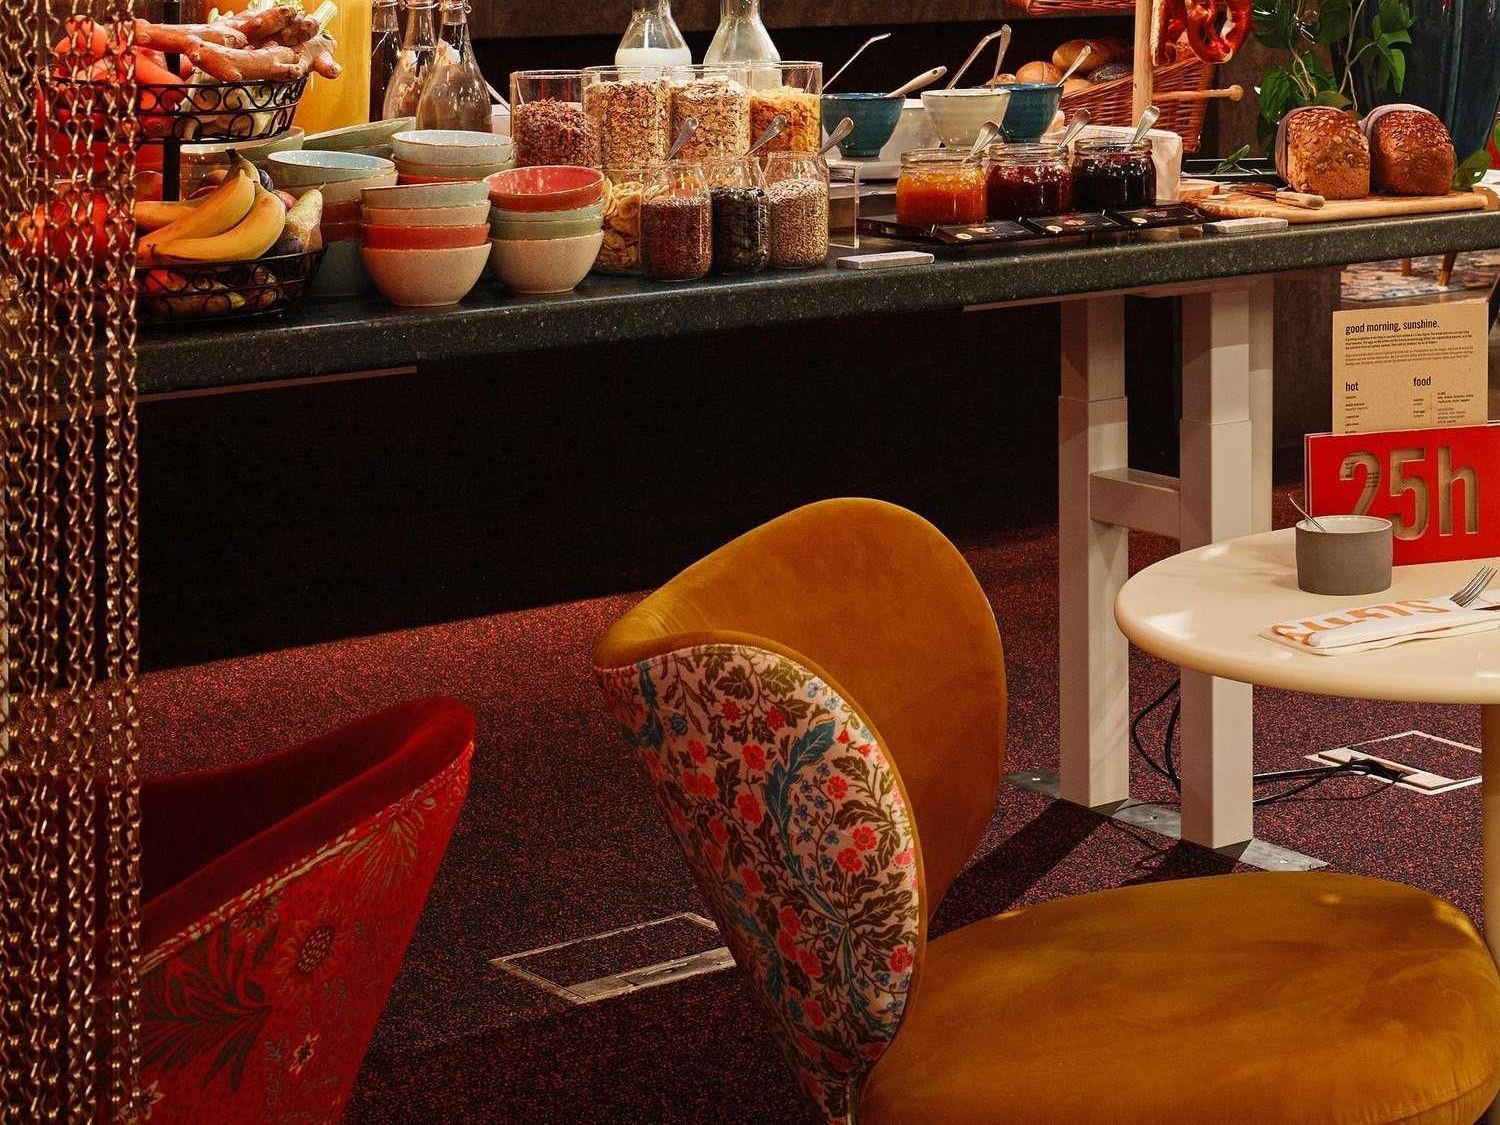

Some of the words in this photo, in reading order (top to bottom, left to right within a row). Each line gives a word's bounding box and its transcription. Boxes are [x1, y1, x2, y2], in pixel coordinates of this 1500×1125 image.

[1345, 322, 1365, 336] good
[1366, 320, 1401, 333] morning,
[1402, 318, 1440, 331] sunshine.
[1345, 382, 1359, 392] hot
[1412, 375, 1432, 387] food
[1338, 445, 1480, 541] 25h
